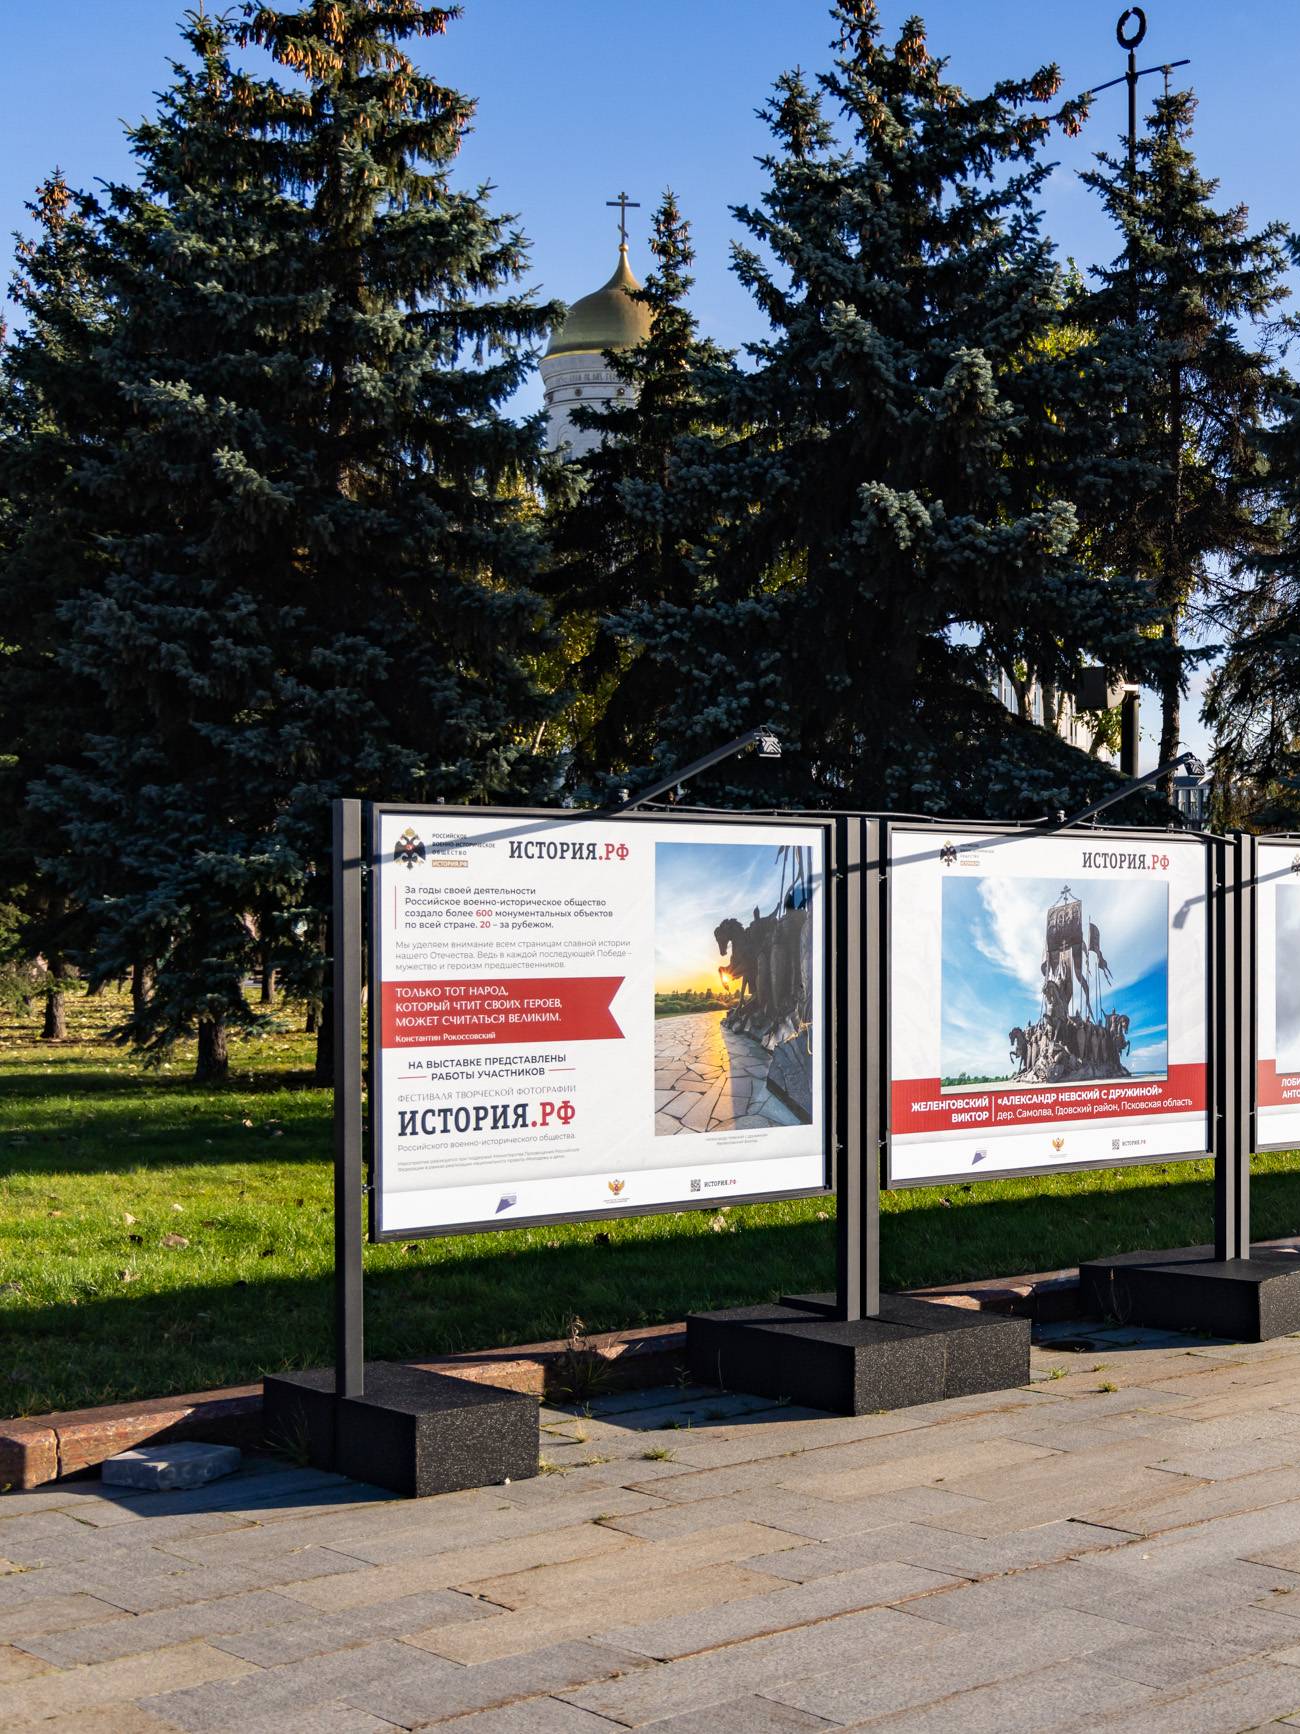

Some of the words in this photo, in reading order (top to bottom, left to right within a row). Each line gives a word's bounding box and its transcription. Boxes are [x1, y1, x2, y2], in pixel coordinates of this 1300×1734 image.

[432, 832, 467, 840] РОССИЙСКОЕ
[509, 841, 629, 860] ИСТОРИЯ.РФ
[1082, 852, 1170, 871] ИСТОРИЯ.РФ
[405, 886, 416, 894] За
[418, 888, 441, 896] годы
[444, 886, 472, 895] своей
[473, 887, 536, 896] деятельности
[405, 898, 461, 906] Российское
[463, 899, 562, 908] военно-историческое
[564, 899, 606, 907] общество
[405, 911, 443, 919] создало
[445, 909, 473, 917] более
[573, 909, 613, 918] объектов
[419, 920, 441, 929] всей
[443, 922, 478, 931] стране.
[480, 921, 491, 929] 20
[511, 921, 554, 931] рубежом.
[412, 941, 449, 950] уделяем
[518, 940, 562, 949] страницам
[564, 939, 596, 947] славной
[598, 939, 631, 948] истории
[395, 952, 427, 960] нашего
[430, 951, 475, 960] Отечества.
[477, 950, 499, 959] Ведь
[506, 950, 537, 959] каждой
[539, 950, 595, 959] последующей
[597, 949, 627, 958] Победе
[395, 963, 437, 972] мужество
[447, 963, 483, 971] героизм
[484, 961, 565, 971] предшественников.
[395, 987, 441, 998] ТОЛЬКО
[444, 986, 466, 996] ТОТ
[469, 986, 509, 996] НАРОД,
[396, 1000, 450, 1012] КОТОРЫЙ
[453, 1000, 481, 1010] ЧТИТ
[484, 999, 521, 1010] СВОИХ
[524, 998, 562, 1009] ГЕРОЕВ,
[395, 1016, 439, 1027] МОЖЕТ
[442, 1014, 505, 1025] СЧИТАТЬСЯ
[508, 1013, 561, 1023] ВЕЛИКИМ.
[395, 1034, 441, 1043] Константин
[443, 1032, 496, 1041] Рокоссовский
[408, 1061, 423, 1070] НА
[426, 1058, 482, 1069] ВЫСТАВКЕ
[484, 1054, 566, 1066] ПРЕДСТАВЛЕНЫ
[431, 1071, 474, 1081] РАБОТЫ
[477, 1068, 545, 1079] УЧАСТНИКОВ
[398, 1091, 453, 1103] ФЕСТИВАЛЯ
[455, 1087, 514, 1099] ТВОРЧЕСКОЙ
[516, 1085, 576, 1095] ФОТОГРАФИИ
[997, 1092, 1057, 1106] «АЛЕКСАНДР
[1058, 1089, 1100, 1102] НЕВСКИЙ
[1101, 1089, 1108, 1098] С
[1109, 1085, 1163, 1099] ДРУЖИНОЙ»
[911, 1096, 989, 1112] ЖЕЛЕНГОВСКИЙ
[997, 1111, 1015, 1121] дер.
[1016, 1107, 1054, 1118] Самолва,
[1055, 1104, 1092, 1116] Гдовский
[1093, 1101, 1119, 1114] район,
[1121, 1099, 1161, 1110] Псковская
[1162, 1097, 1193, 1108] область
[398, 1100, 576, 1137] ИСТОРИЯ.РФ
[951, 1111, 989, 1123] ВИКТОР
[398, 1142, 448, 1152] Российского
[450, 1135, 538, 1149] военно-исторического
[539, 1132, 576, 1142] общества.
[704, 1179, 736, 1188] ИСТОРИЯ.РФ
